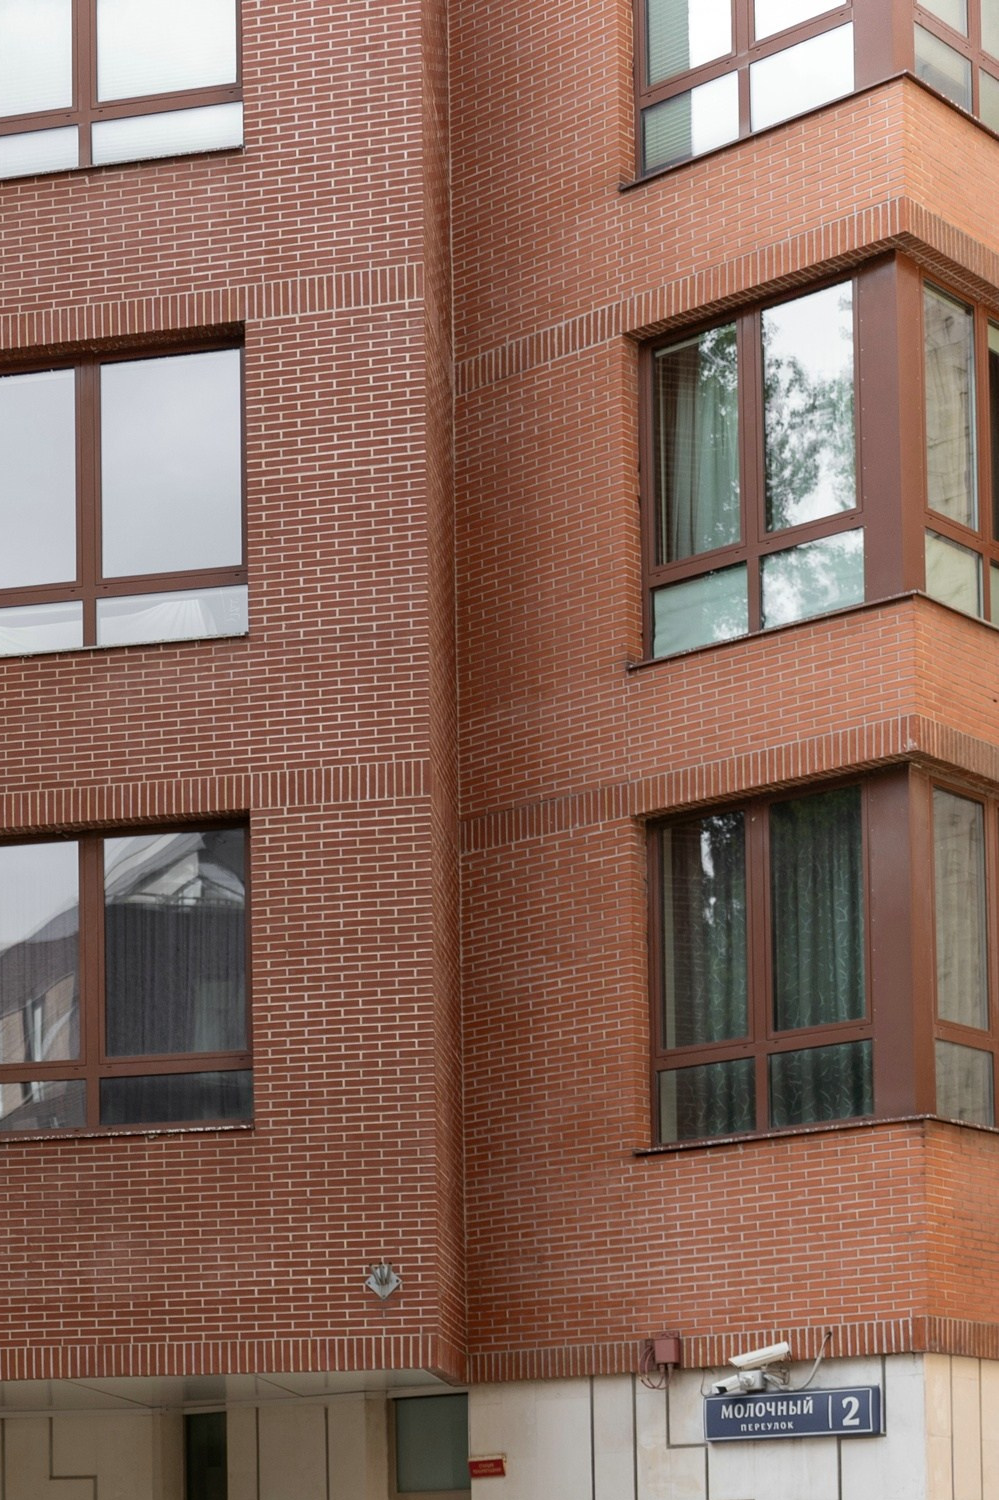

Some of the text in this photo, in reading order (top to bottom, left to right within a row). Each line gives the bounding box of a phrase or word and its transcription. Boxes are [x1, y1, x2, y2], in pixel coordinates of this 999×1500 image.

[721, 1397, 813, 1419] МОЛОЧНЫЙ
[842, 1396, 860, 1426] 2
[741, 1421, 794, 1432] ПЕРЕУЛОК
